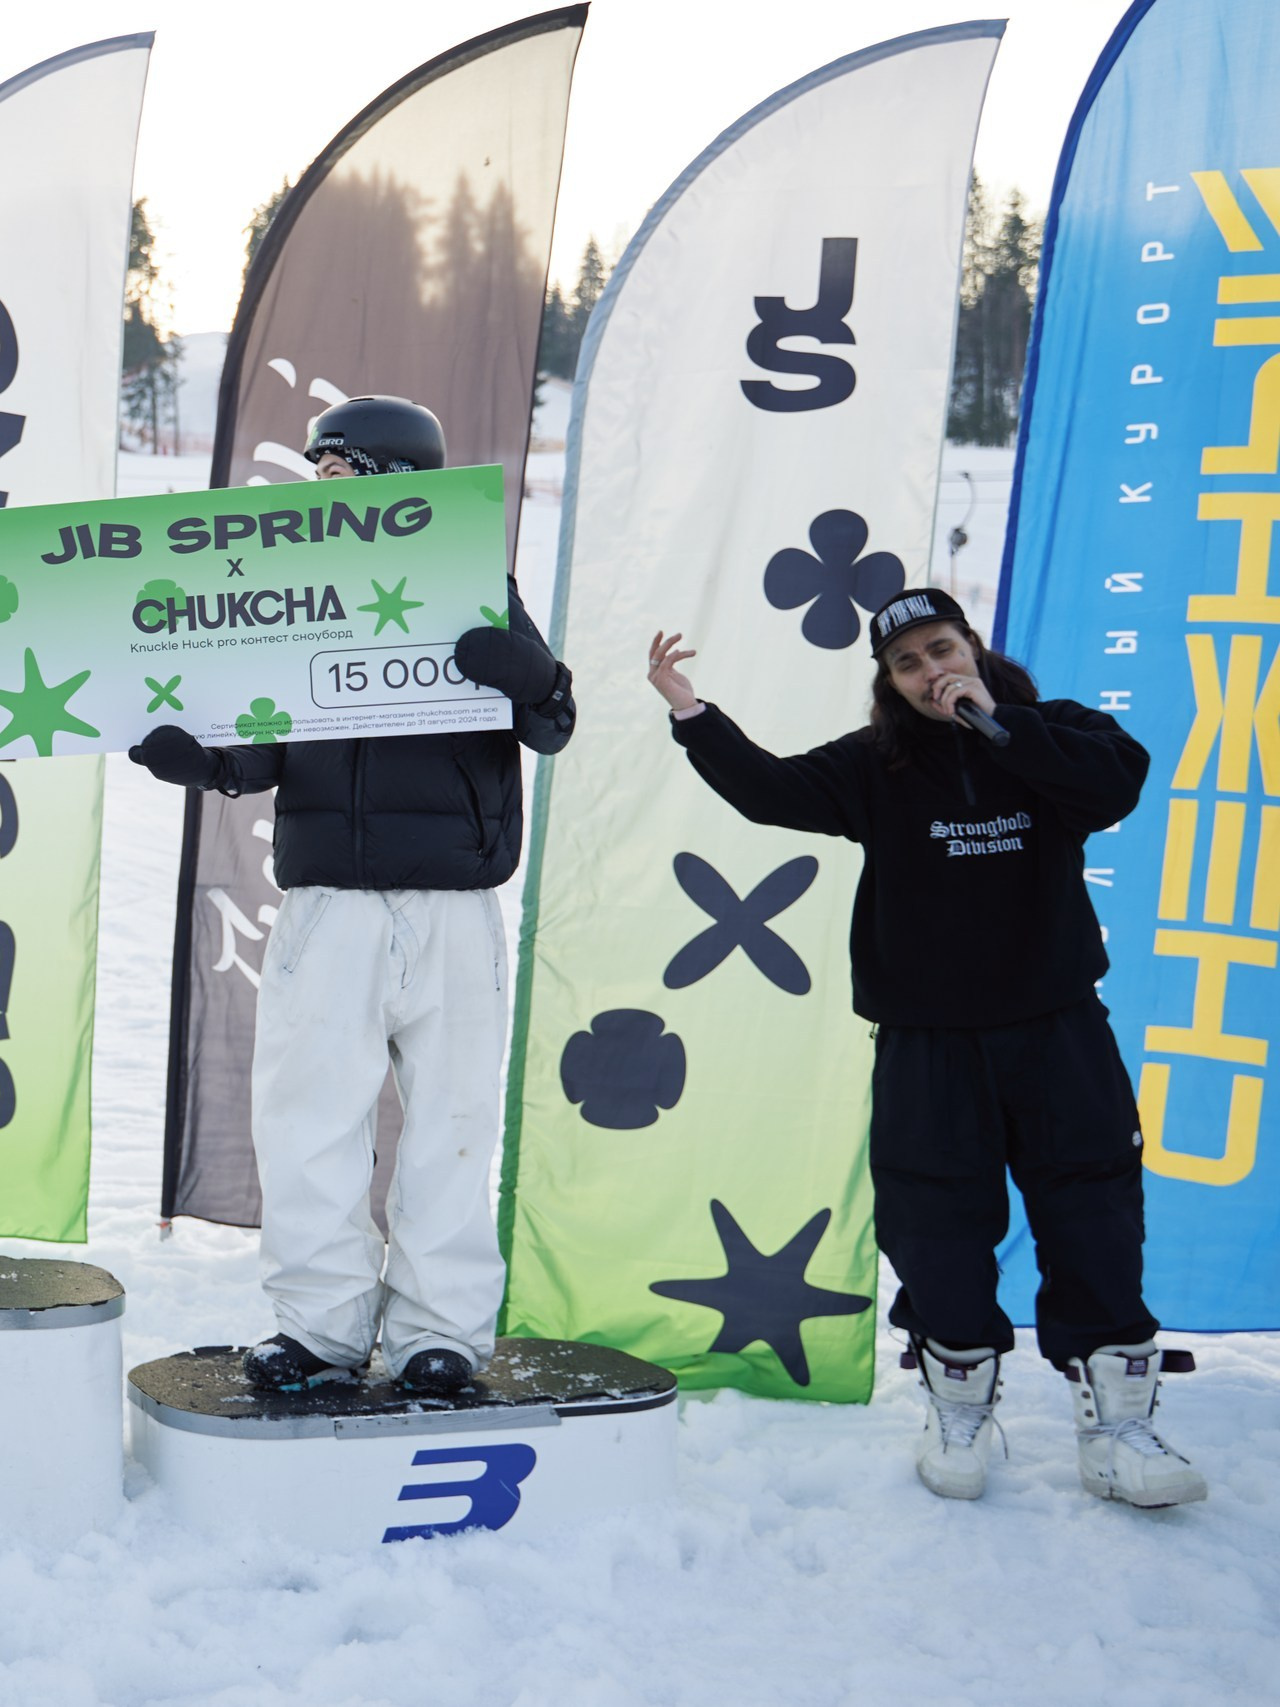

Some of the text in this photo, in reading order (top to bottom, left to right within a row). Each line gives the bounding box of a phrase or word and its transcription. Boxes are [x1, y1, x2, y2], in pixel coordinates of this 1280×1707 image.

[1119, 182, 1180, 503] КУРОРТ
[318, 438, 344, 446] GIRO
[40, 497, 432, 565] JIB SPRING
[132, 584, 347, 635] CHUKCHA
[130, 629, 353, 653] Knuckle Huck pro контест сноуборд
[328, 654, 480, 692] 15 000
[210, 721, 255, 731] Сертификат
[284, 717, 335, 726] использовать
[342, 712, 415, 722] интернет-магазине
[416, 708, 470, 718] chukchas.com
[276, 727, 302, 735] деньги
[352, 720, 405, 731] Действителен
[406, 720, 417, 728] до
[428, 718, 456, 727] августа
[458, 716, 477, 724] 2024
[929, 811, 1031, 839] Stronghold
[946, 837, 1024, 857] Division
[381, 1443, 537, 1544] 3
